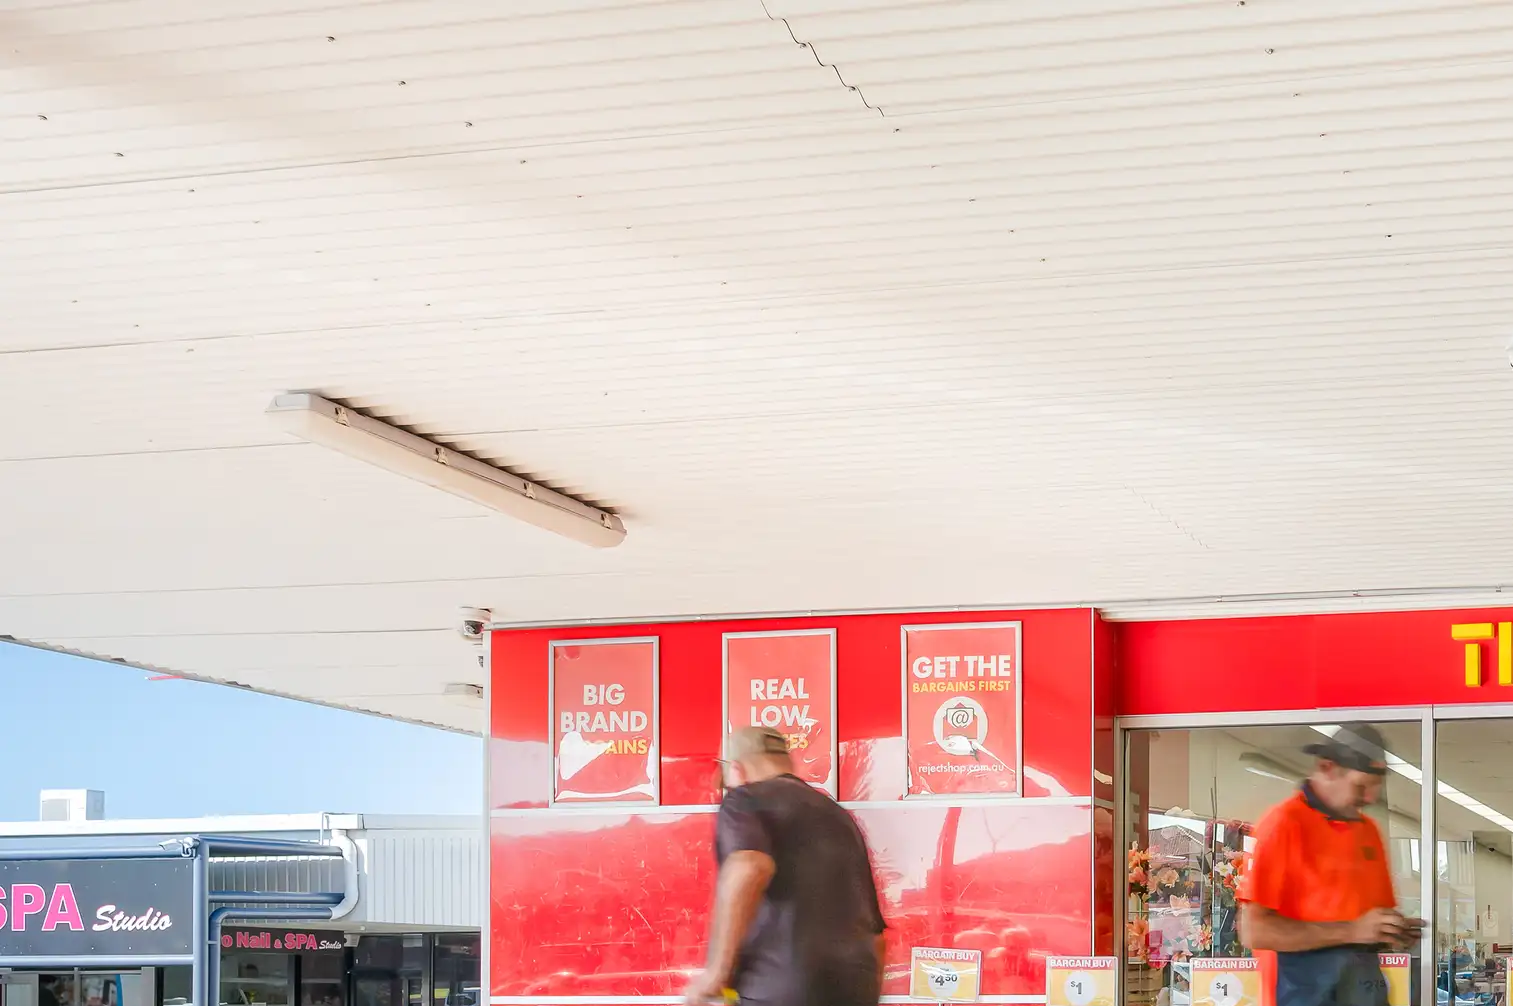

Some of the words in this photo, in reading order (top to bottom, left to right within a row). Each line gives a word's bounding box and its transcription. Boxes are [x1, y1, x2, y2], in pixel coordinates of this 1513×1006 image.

[912, 656, 960, 679] GET
[963, 655, 1011, 677] THE
[750, 677, 810, 700] REAL
[912, 681, 976, 693] BARGAINS
[978, 680, 1011, 691] FIRST
[583, 683, 626, 706] BIG
[560, 710, 648, 733] BRAND
[750, 704, 811, 728] LOW
[918, 762, 1005, 775] rejectshop.com.au
[0, 883, 85, 932] PA
[92, 904, 173, 932] Studio
[236, 931, 271, 949] Nail
[273, 939, 283, 949] &
[284, 933, 318, 950] SPA
[318, 940, 342, 950] Studio
[916, 949, 956, 960] BARGAIN
[956, 952, 975, 960] BUY
[1385, 956, 1406, 965] BUY
[1050, 960, 1092, 968] BARGAIN
[1092, 960, 1112, 968] BUY
[1194, 960, 1238, 969] BARGAIN
[1238, 960, 1259, 969] BUY
[1070, 981, 1083, 995] $1
[1216, 982, 1228, 996] $1
